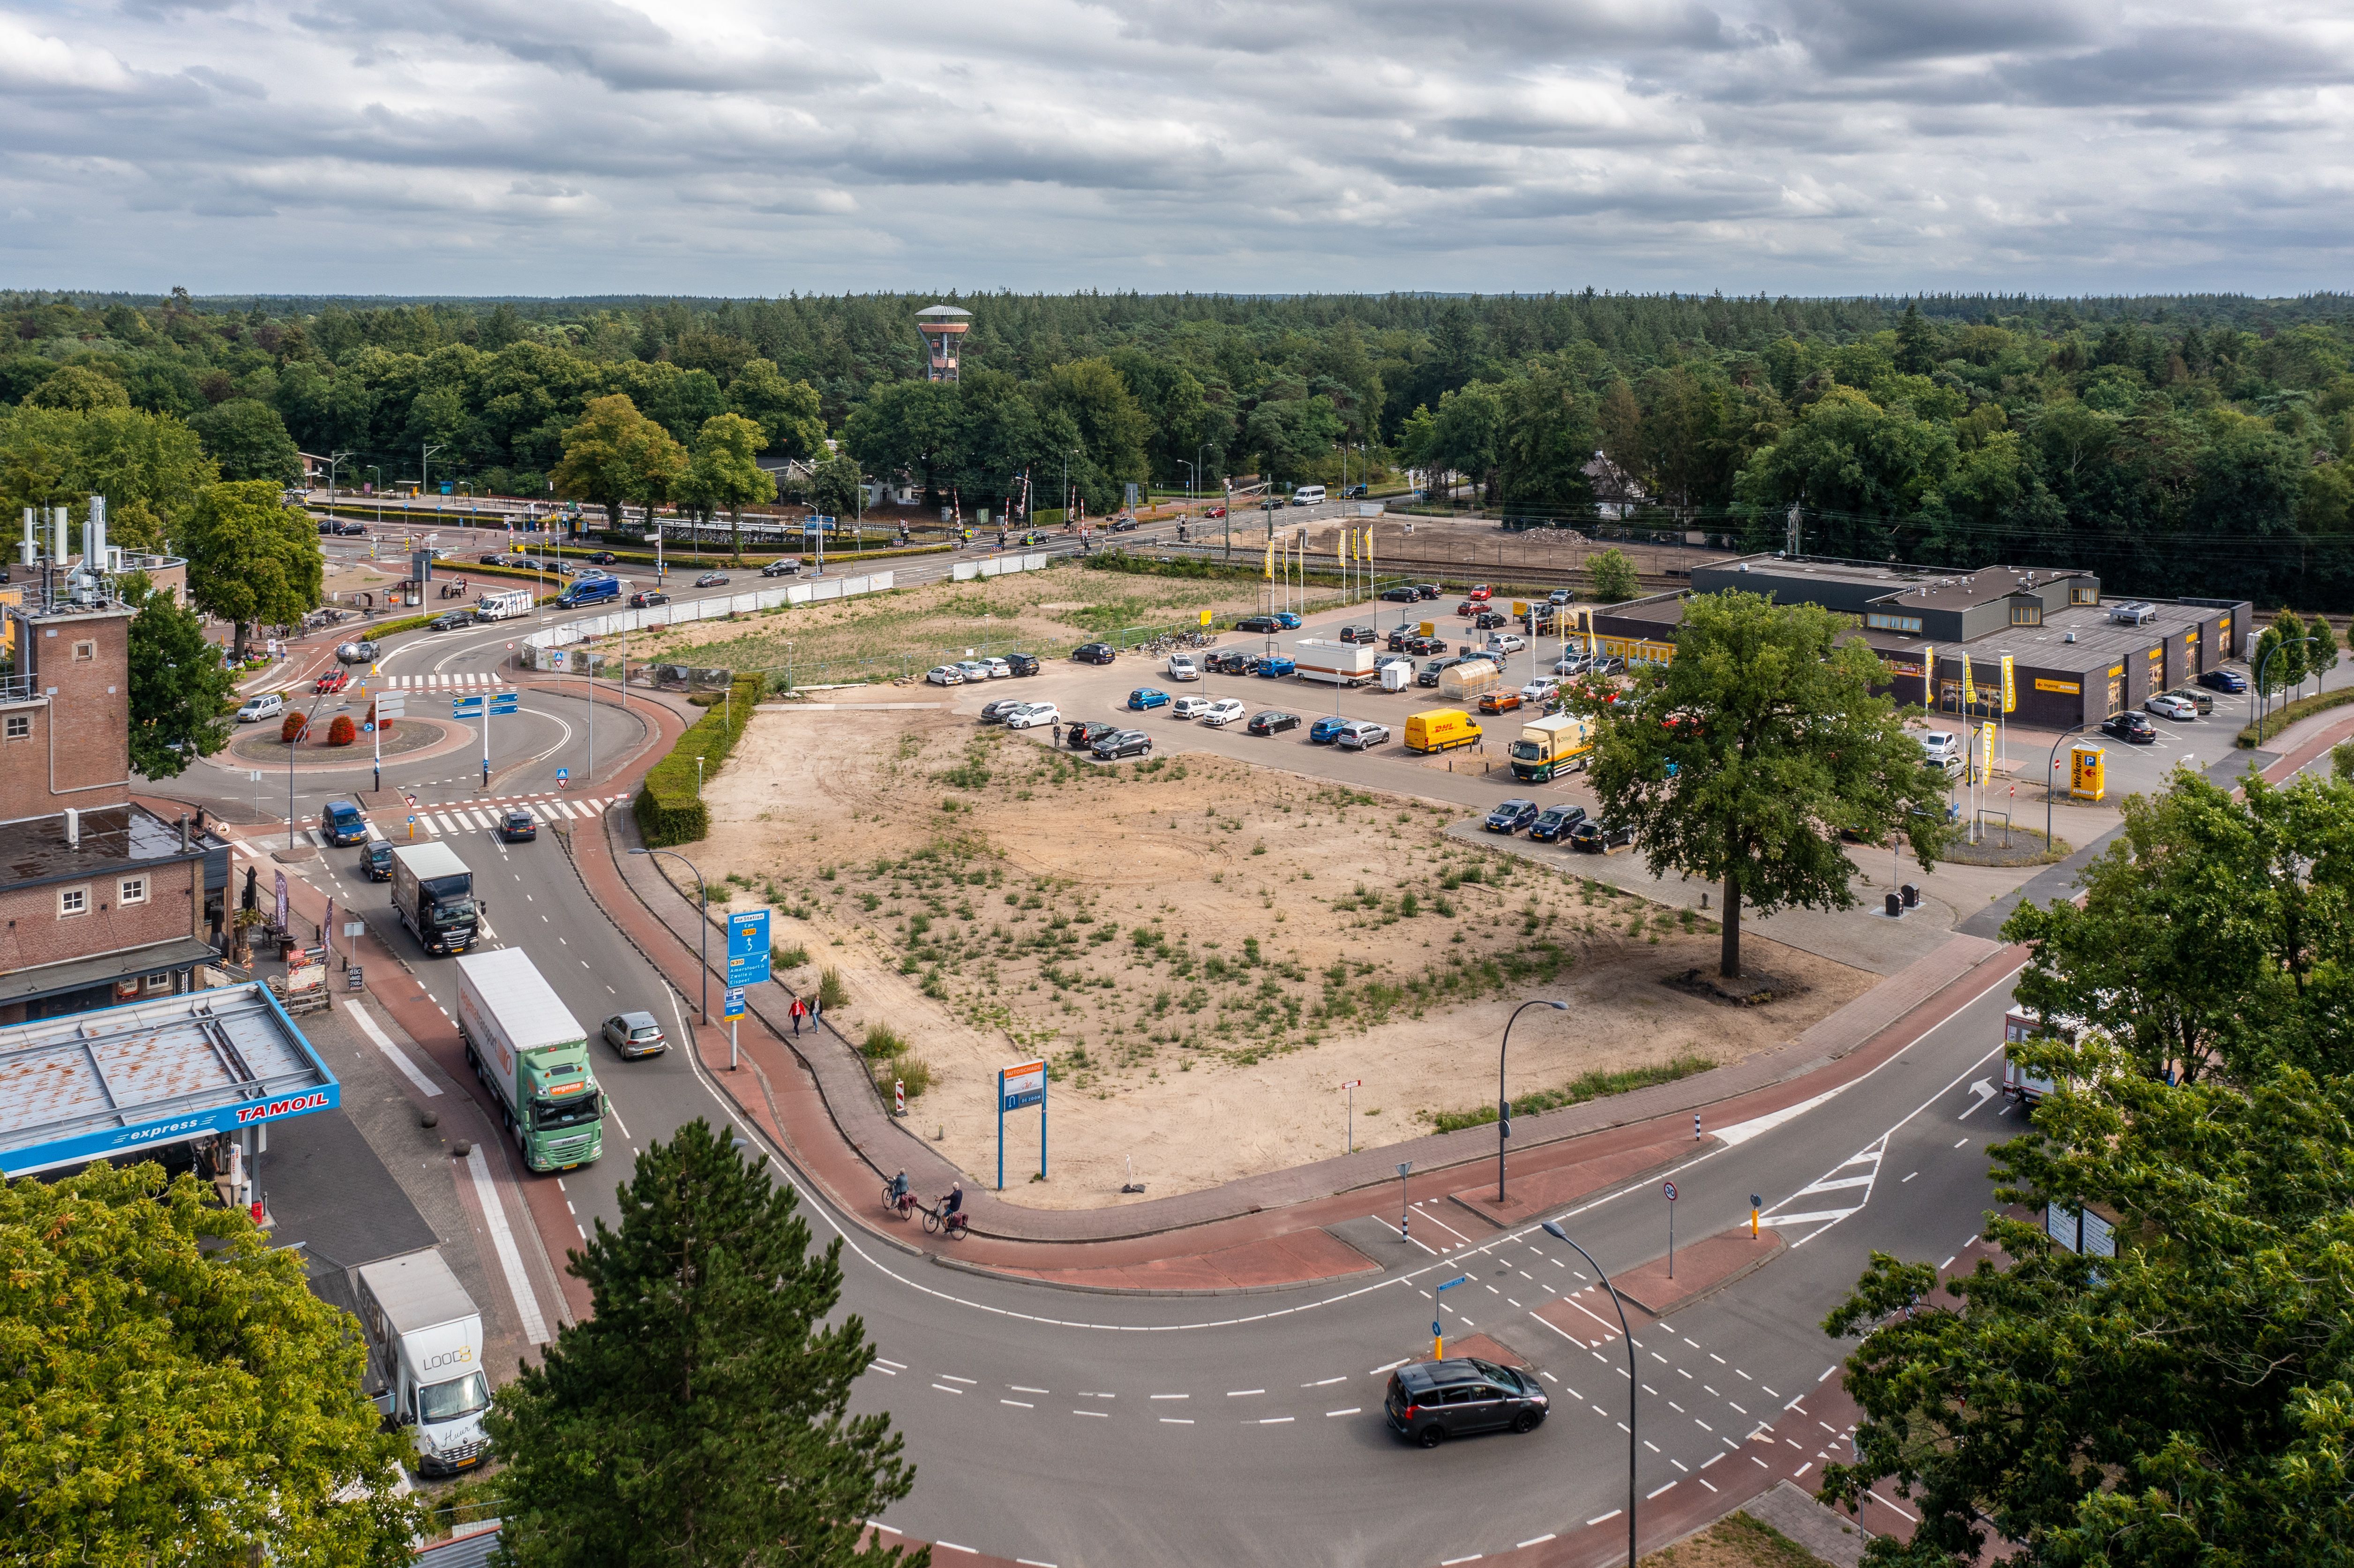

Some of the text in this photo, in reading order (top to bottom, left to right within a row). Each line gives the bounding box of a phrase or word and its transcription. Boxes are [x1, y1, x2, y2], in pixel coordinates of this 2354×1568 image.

[2108, 665, 2123, 678] JUMBO
[1435, 723, 1454, 733] DHL
[2073, 750, 2082, 788] Welkom!
[730, 964, 760, 973] Amersfoort
[1006, 1064, 1042, 1076] AUTOSCHADE
[552, 1082, 581, 1094] oegema
[130, 1092, 329, 1140] express TAMOIL
[1666, 1187, 1675, 1197] 30
[442, 1426, 471, 1448] Huur
